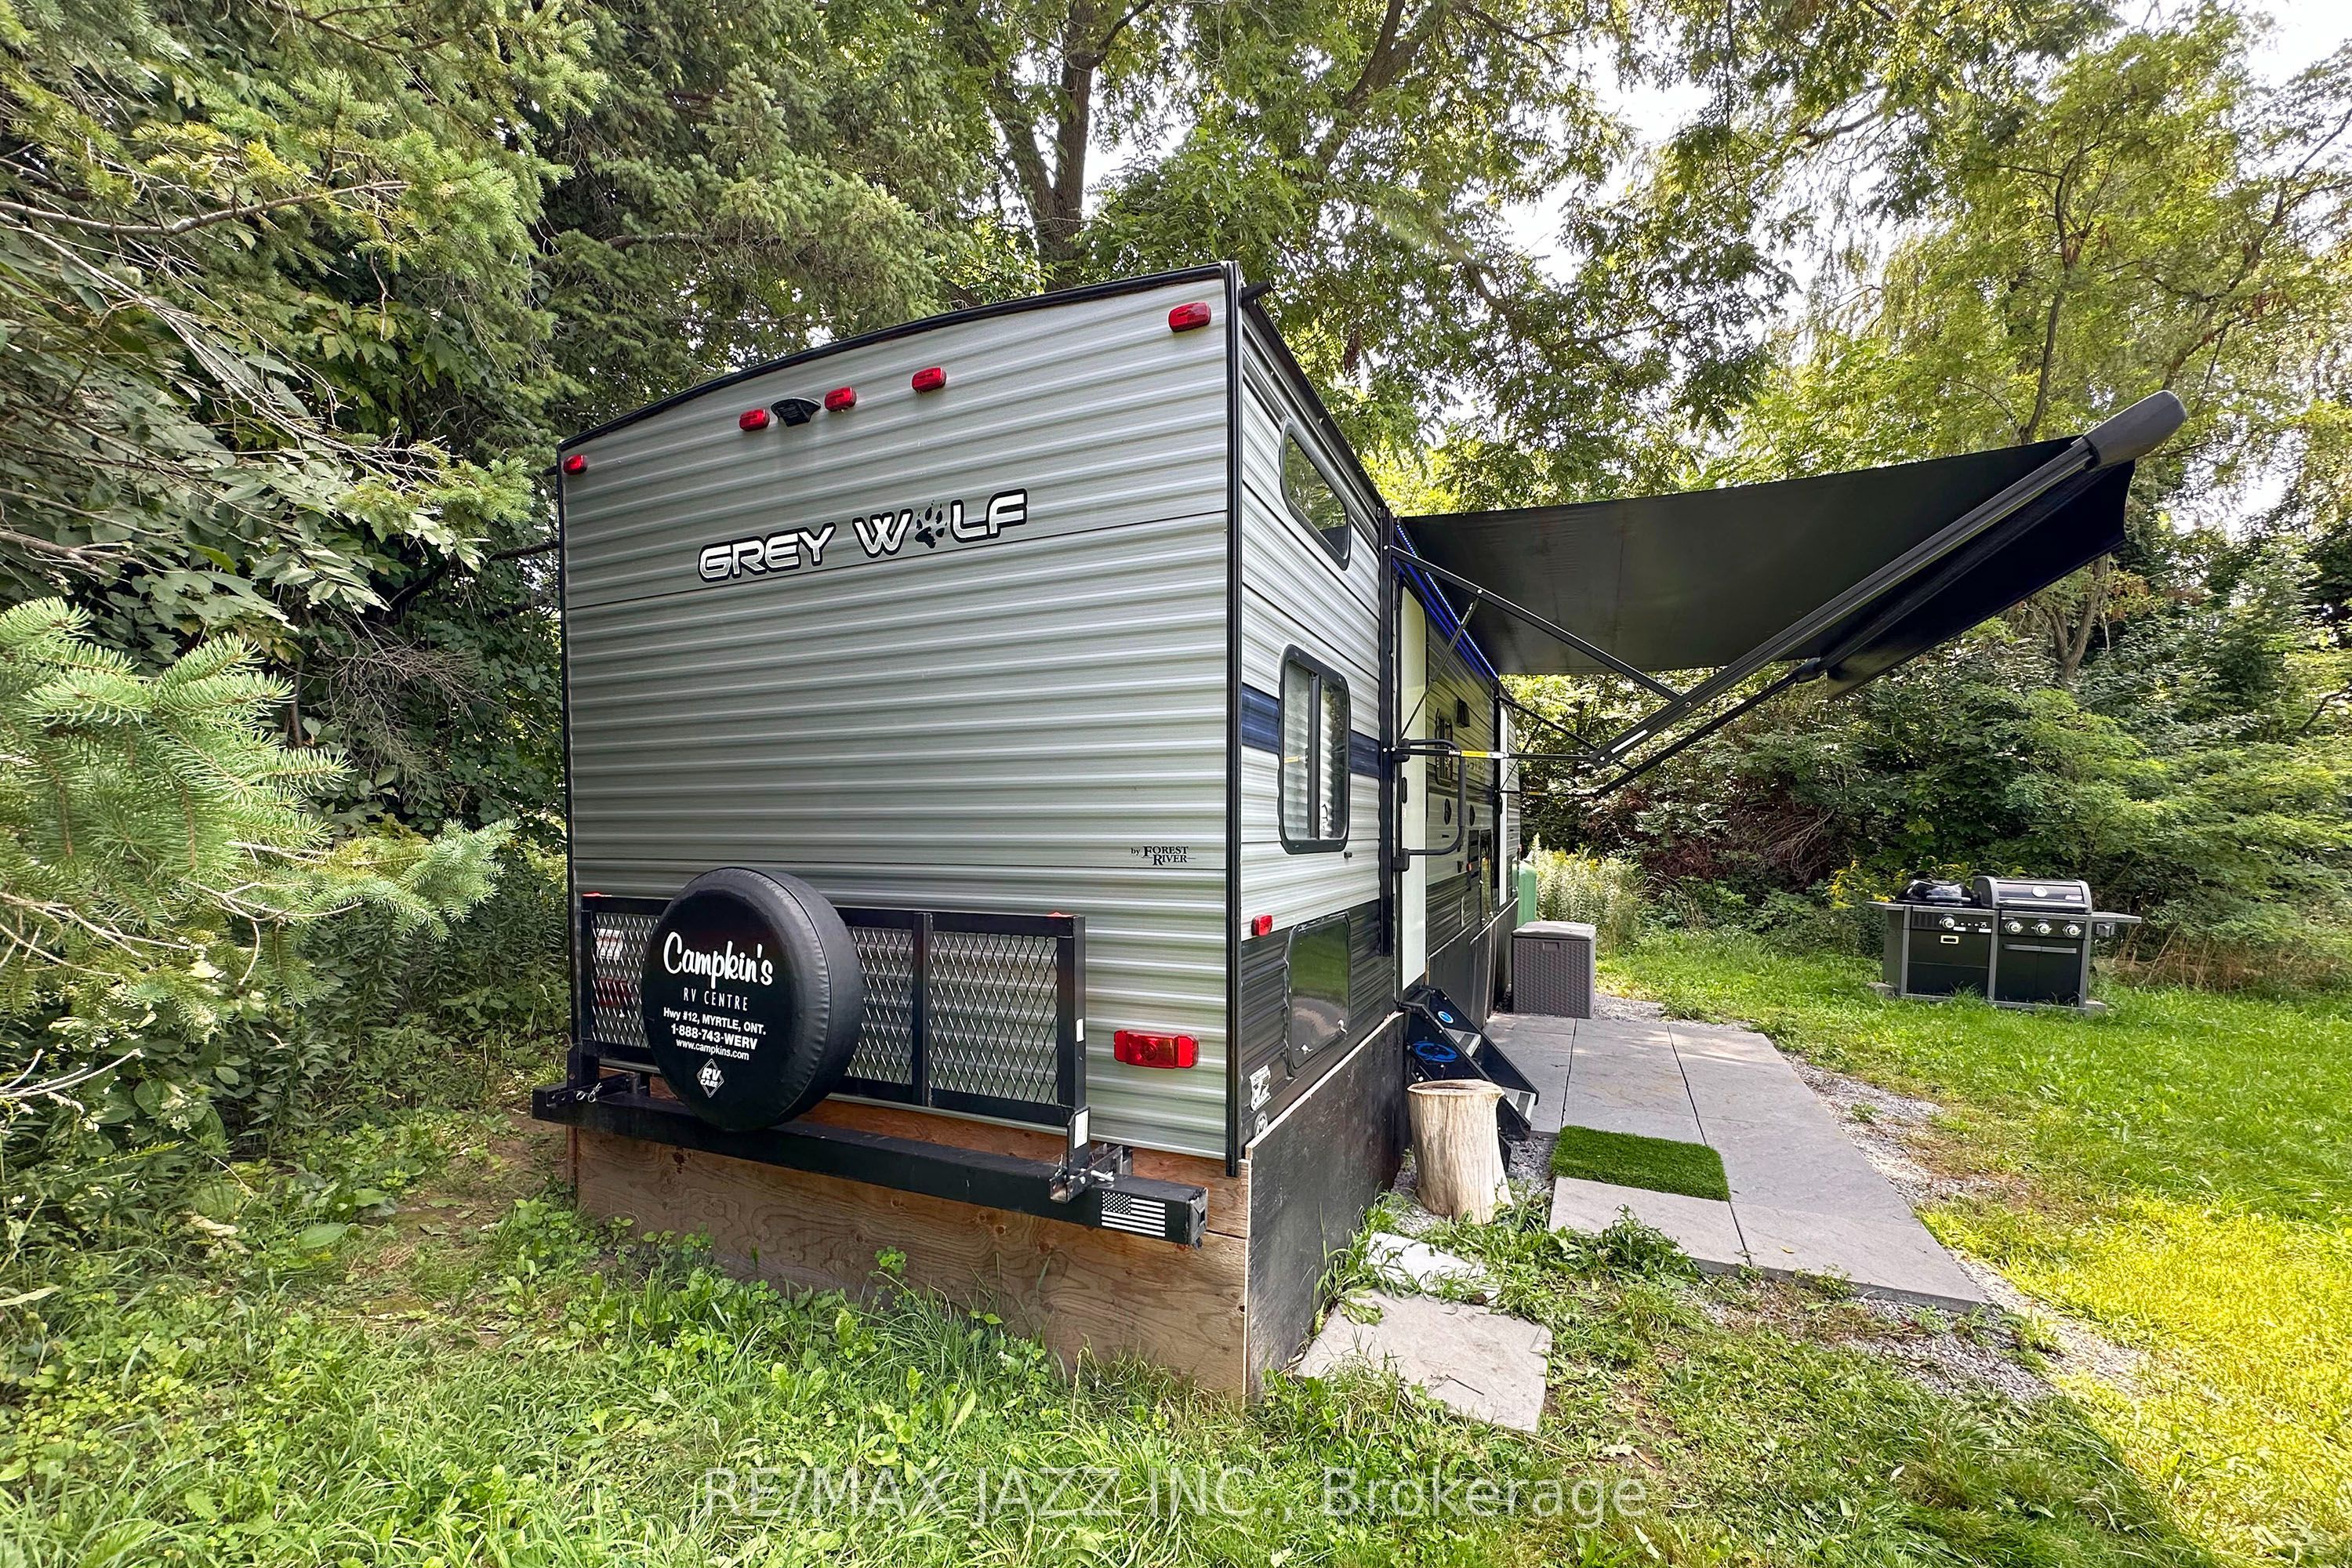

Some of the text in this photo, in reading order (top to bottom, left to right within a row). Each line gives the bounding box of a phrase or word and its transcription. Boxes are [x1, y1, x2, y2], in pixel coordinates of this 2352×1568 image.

[699, 489, 1027, 581] GREY WLF
[1142, 846, 1189, 857] FOREST
[1152, 854, 1188, 866] RIVER
[663, 931, 773, 989] Campkin's
[684, 987, 748, 1011] RV CENTRE
[663, 1007, 767, 1036] Hwy #12, MYRTLE, ONT.
[671, 1023, 758, 1050] 1-888-743-WERV
[676, 1039, 750, 1061] www.campkins.com
[700, 1079, 719, 1088] CARE
[701, 1067, 721, 1081] RV
